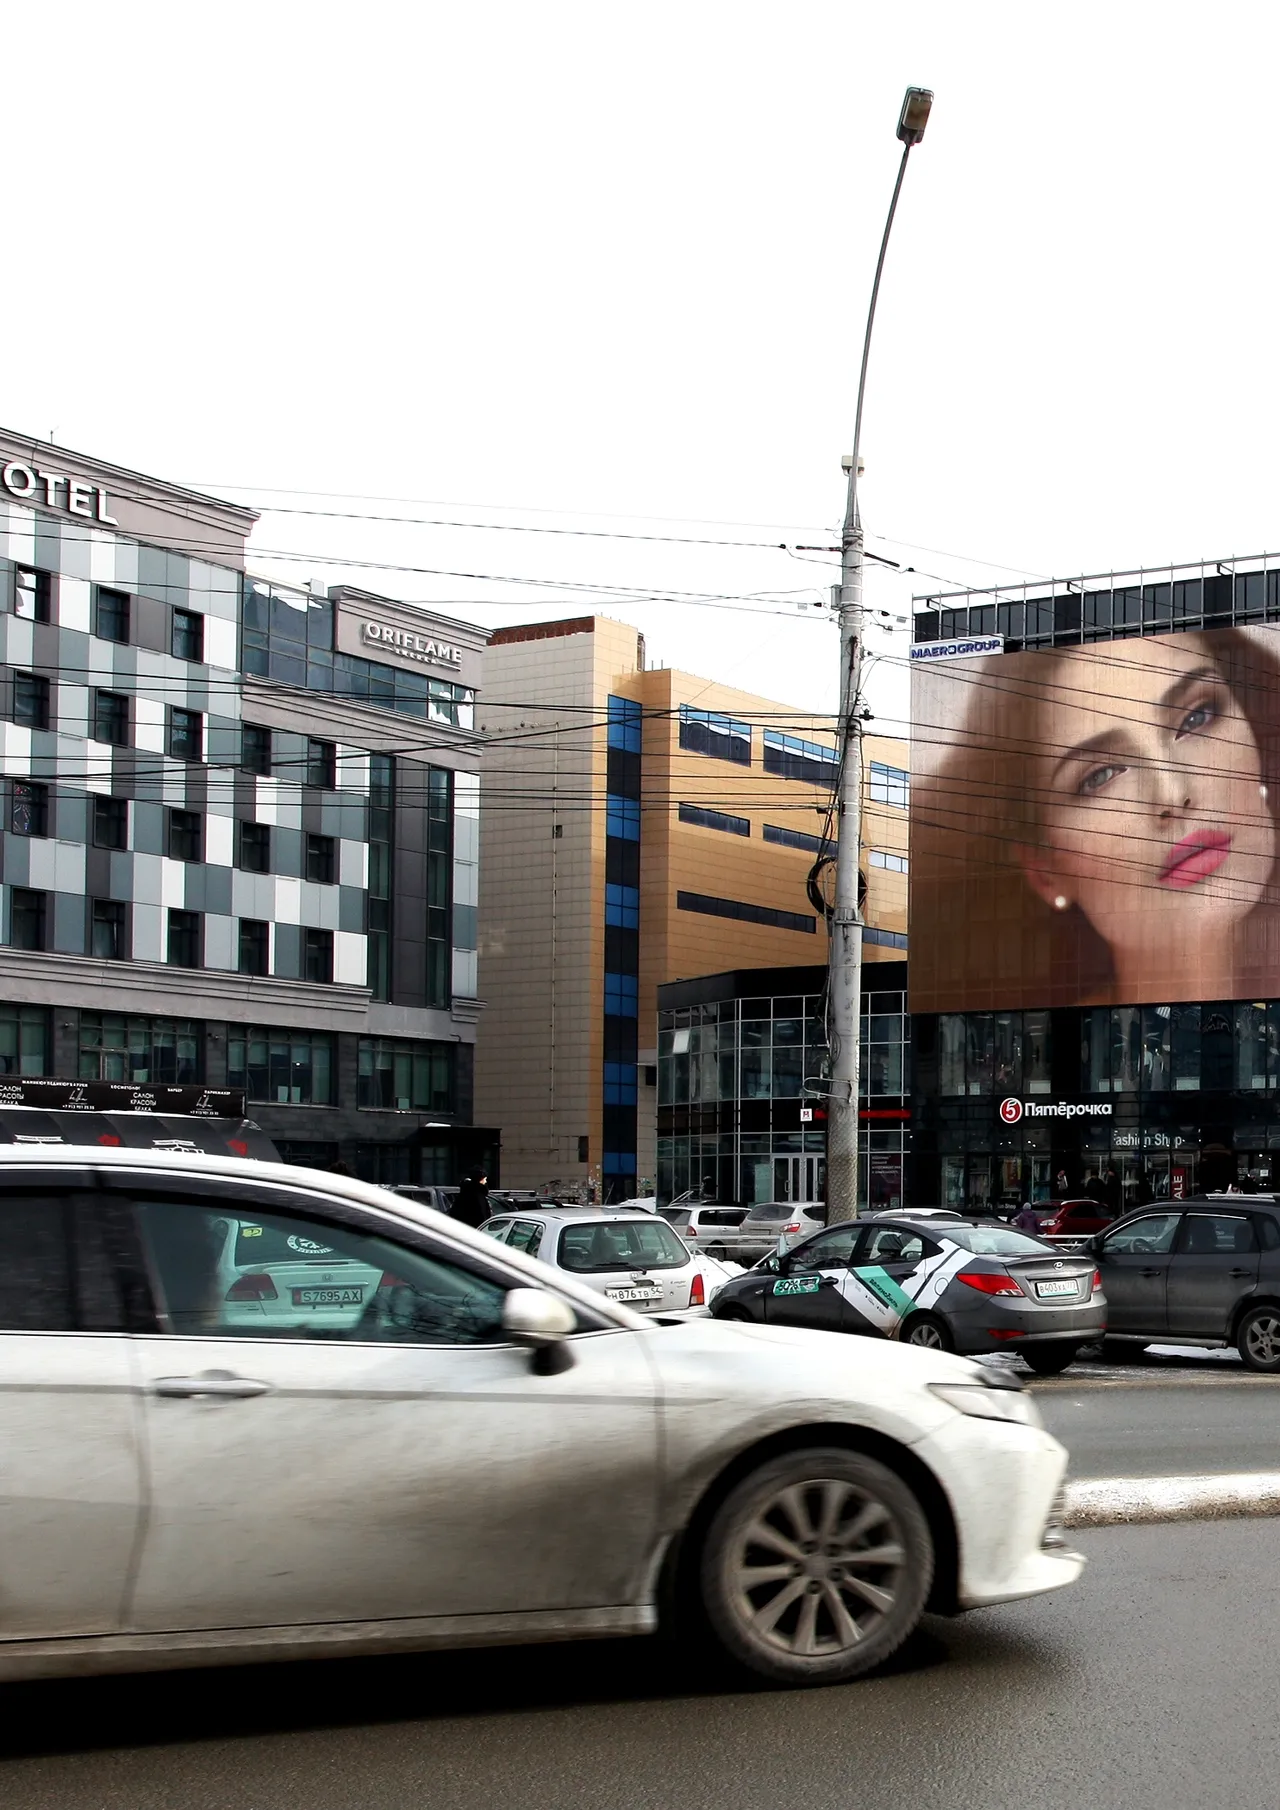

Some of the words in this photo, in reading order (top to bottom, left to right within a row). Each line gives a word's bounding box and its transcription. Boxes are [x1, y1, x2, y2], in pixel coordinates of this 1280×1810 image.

[3, 461, 120, 527] OTEL
[366, 621, 463, 664] ORIFLAME
[0, 1092, 25, 1100] РАСОТЫ
[130, 1099, 157, 1107] КРАСОТЫ
[1024, 1101, 1113, 1120] Пятёрочка
[1154, 1132, 1182, 1149] Shp
[1173, 1175, 1183, 1200] ALE
